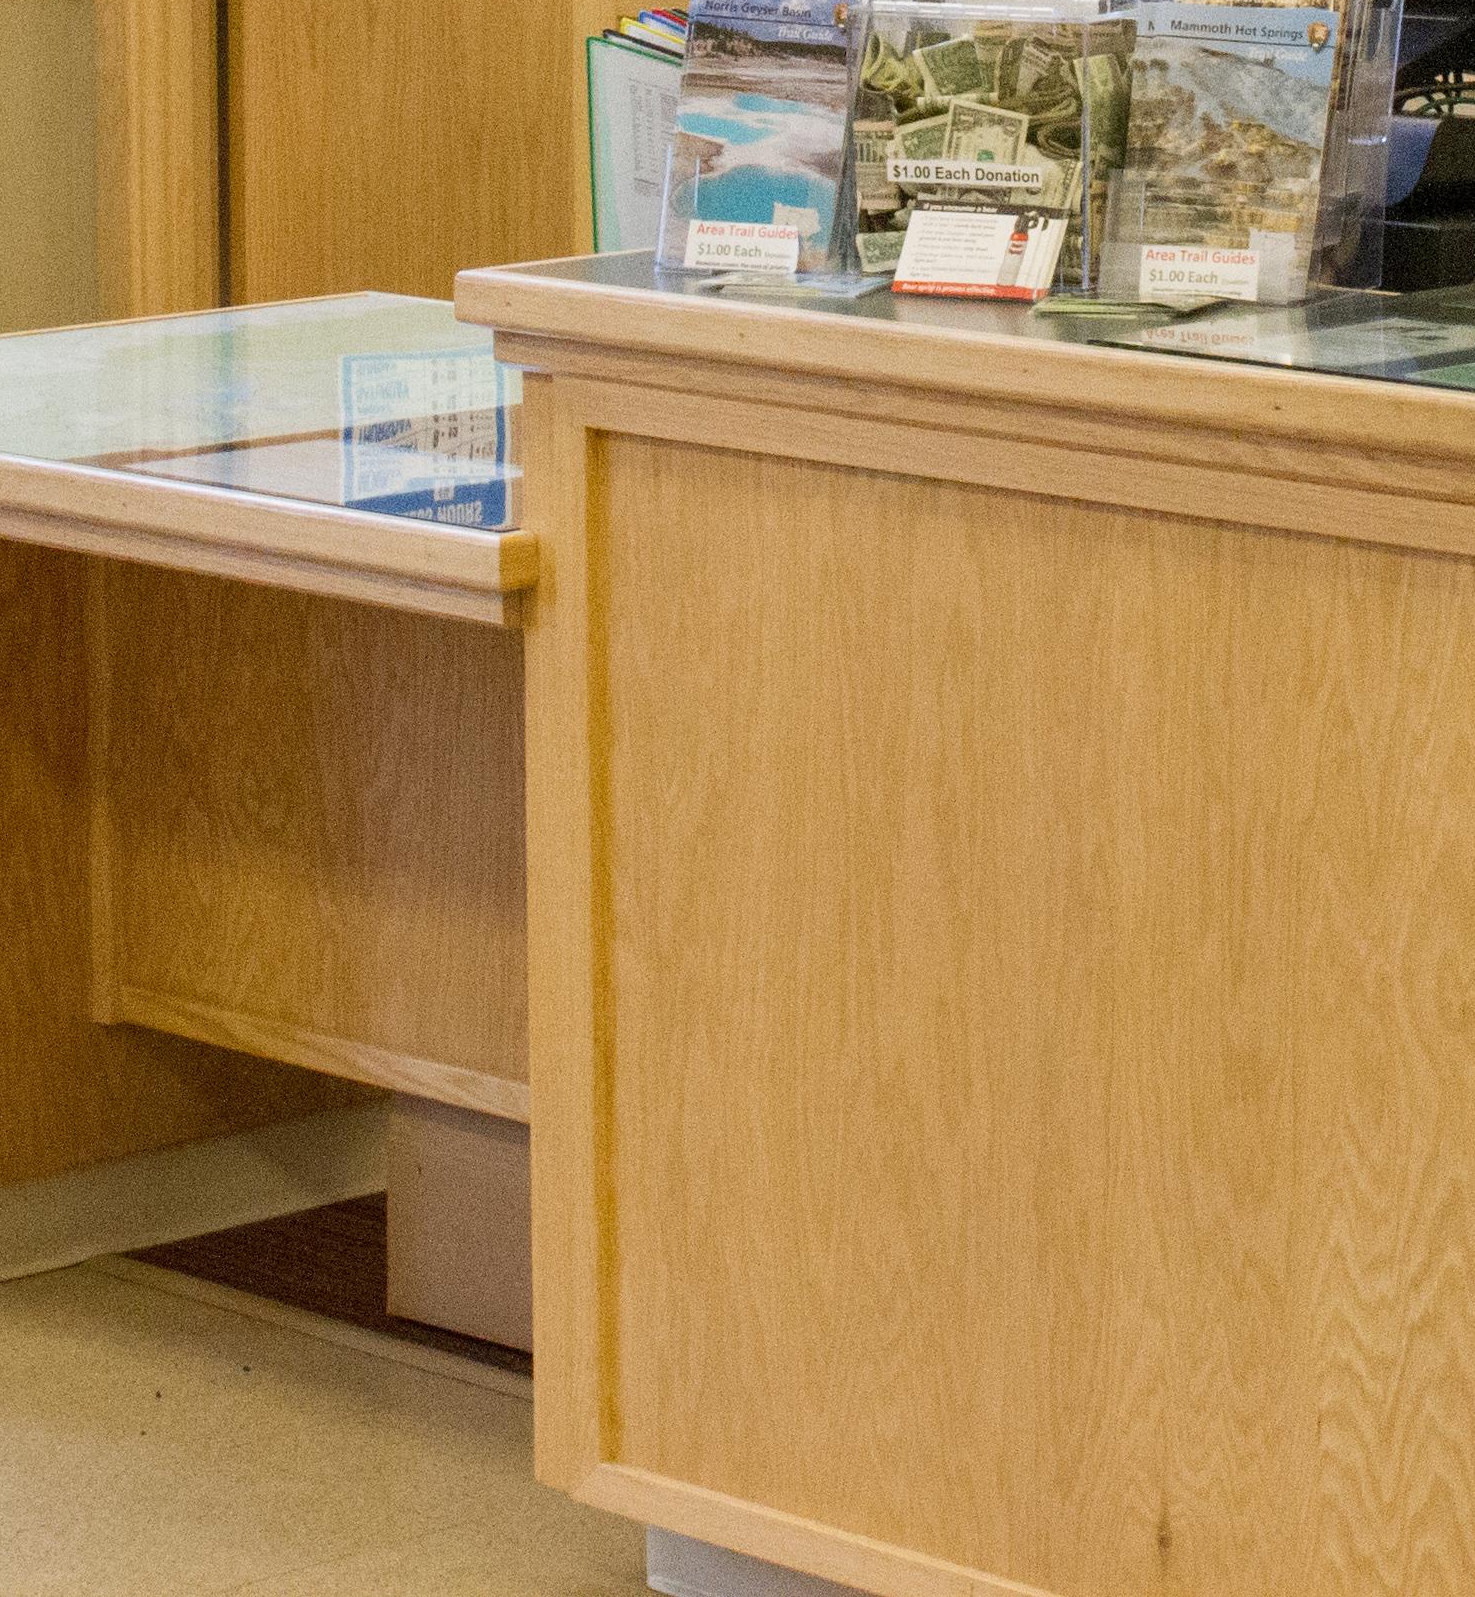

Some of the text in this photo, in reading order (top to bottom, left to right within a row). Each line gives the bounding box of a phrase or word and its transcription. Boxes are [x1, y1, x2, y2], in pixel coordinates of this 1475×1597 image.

[705, 0, 812, 19] Norris Geyser Basin
[1170, 20, 1231, 35] Mammoth
[1236, 23, 1258, 36] Hot
[1261, 24, 1304, 42] Springs
[893, 164, 1039, 184] $1.00 Each Donation
[697, 223, 799, 239] Area Trail Guides
[698, 242, 762, 257] $1.00 Each
[1145, 249, 1255, 265] Area Trail Guides
[1149, 270, 1218, 284] $1.00 Each
